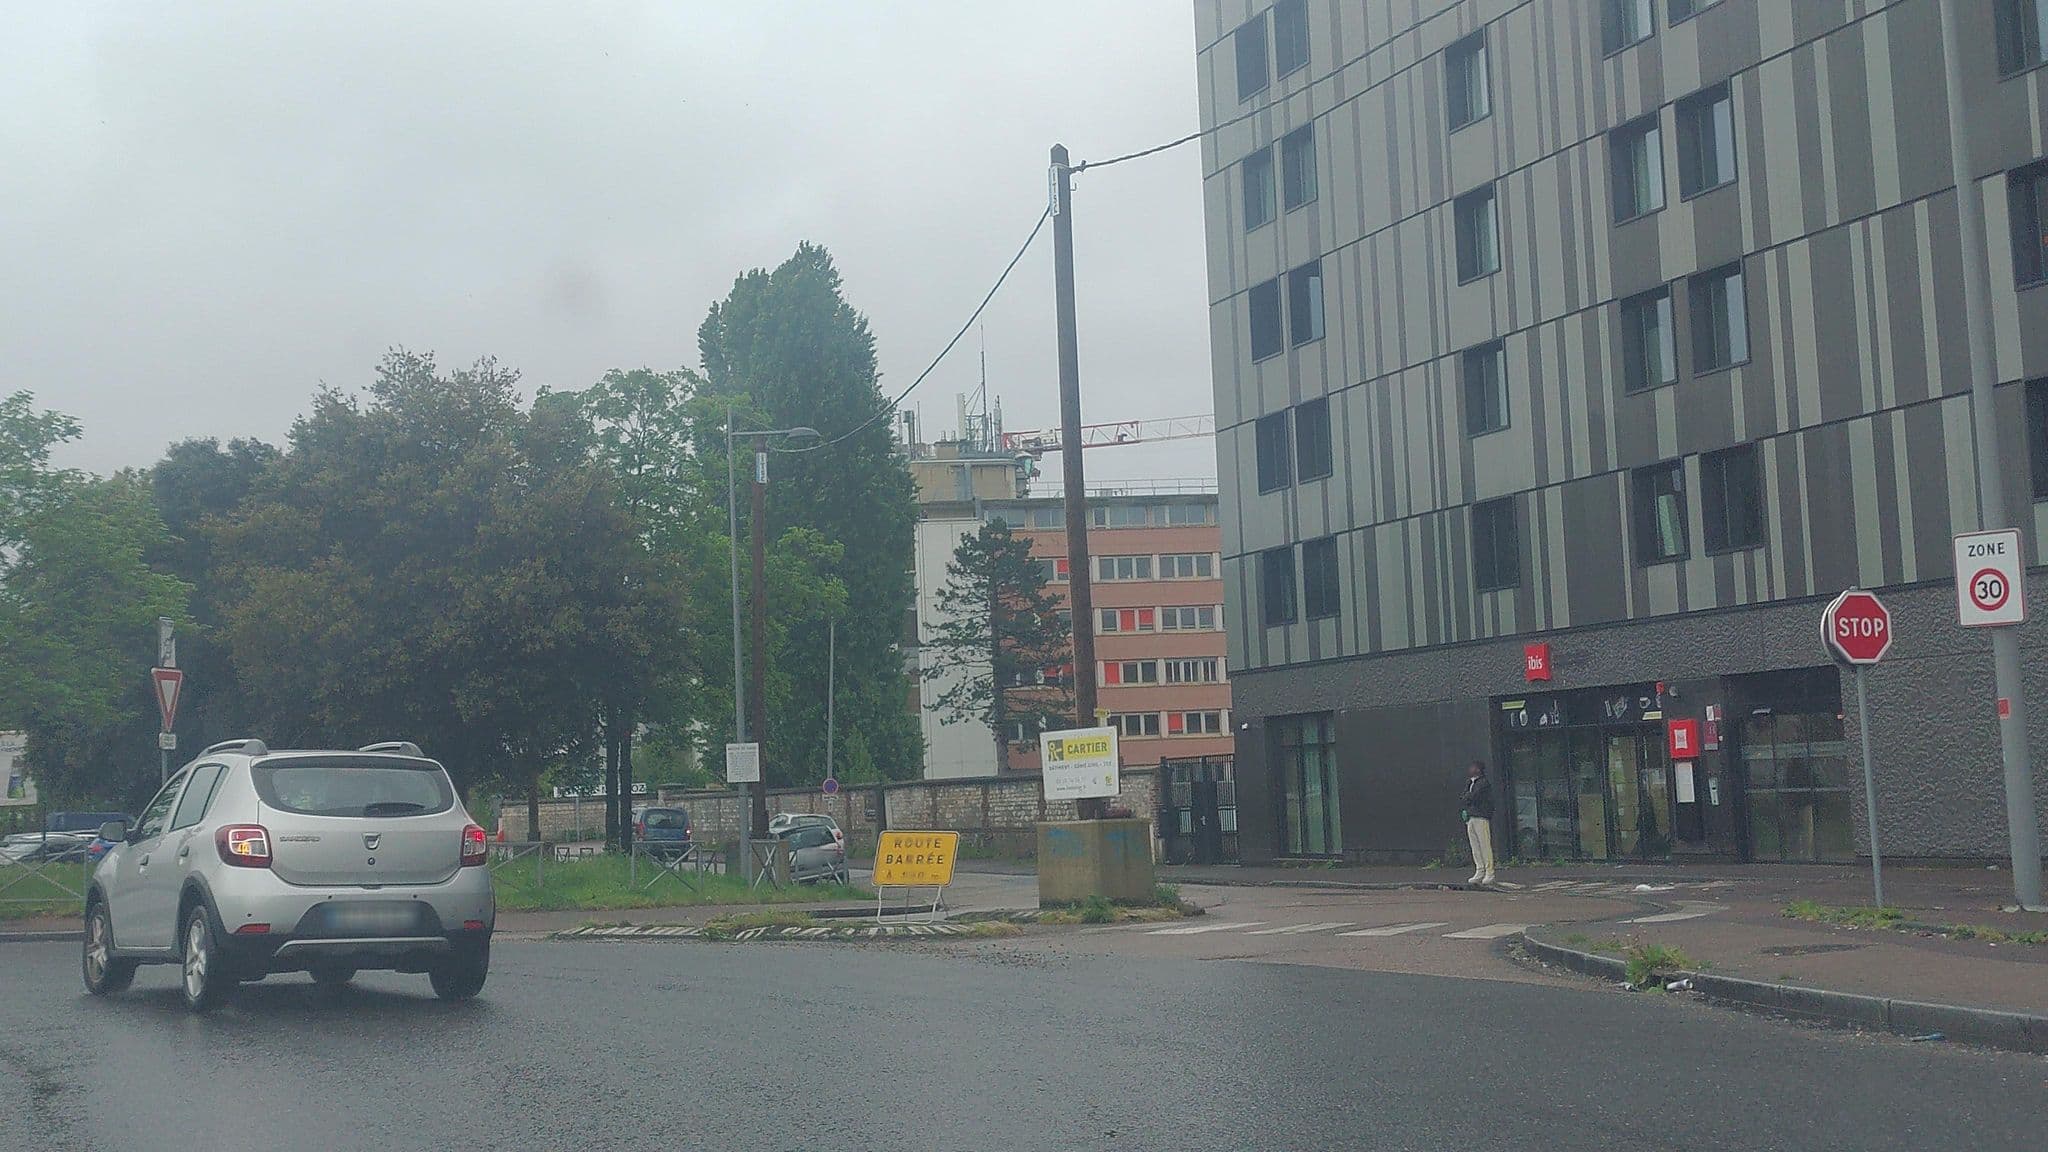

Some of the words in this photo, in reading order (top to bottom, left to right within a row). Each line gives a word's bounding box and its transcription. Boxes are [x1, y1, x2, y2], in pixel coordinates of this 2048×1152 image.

[1968, 542, 2005, 557] ZONE
[1977, 580, 2002, 600] 30
[1839, 617, 1884, 638] STOP
[1528, 655, 1543, 670] ibis
[1067, 742, 1108, 754] CARTIER
[894, 838, 943, 848] ROUTE
